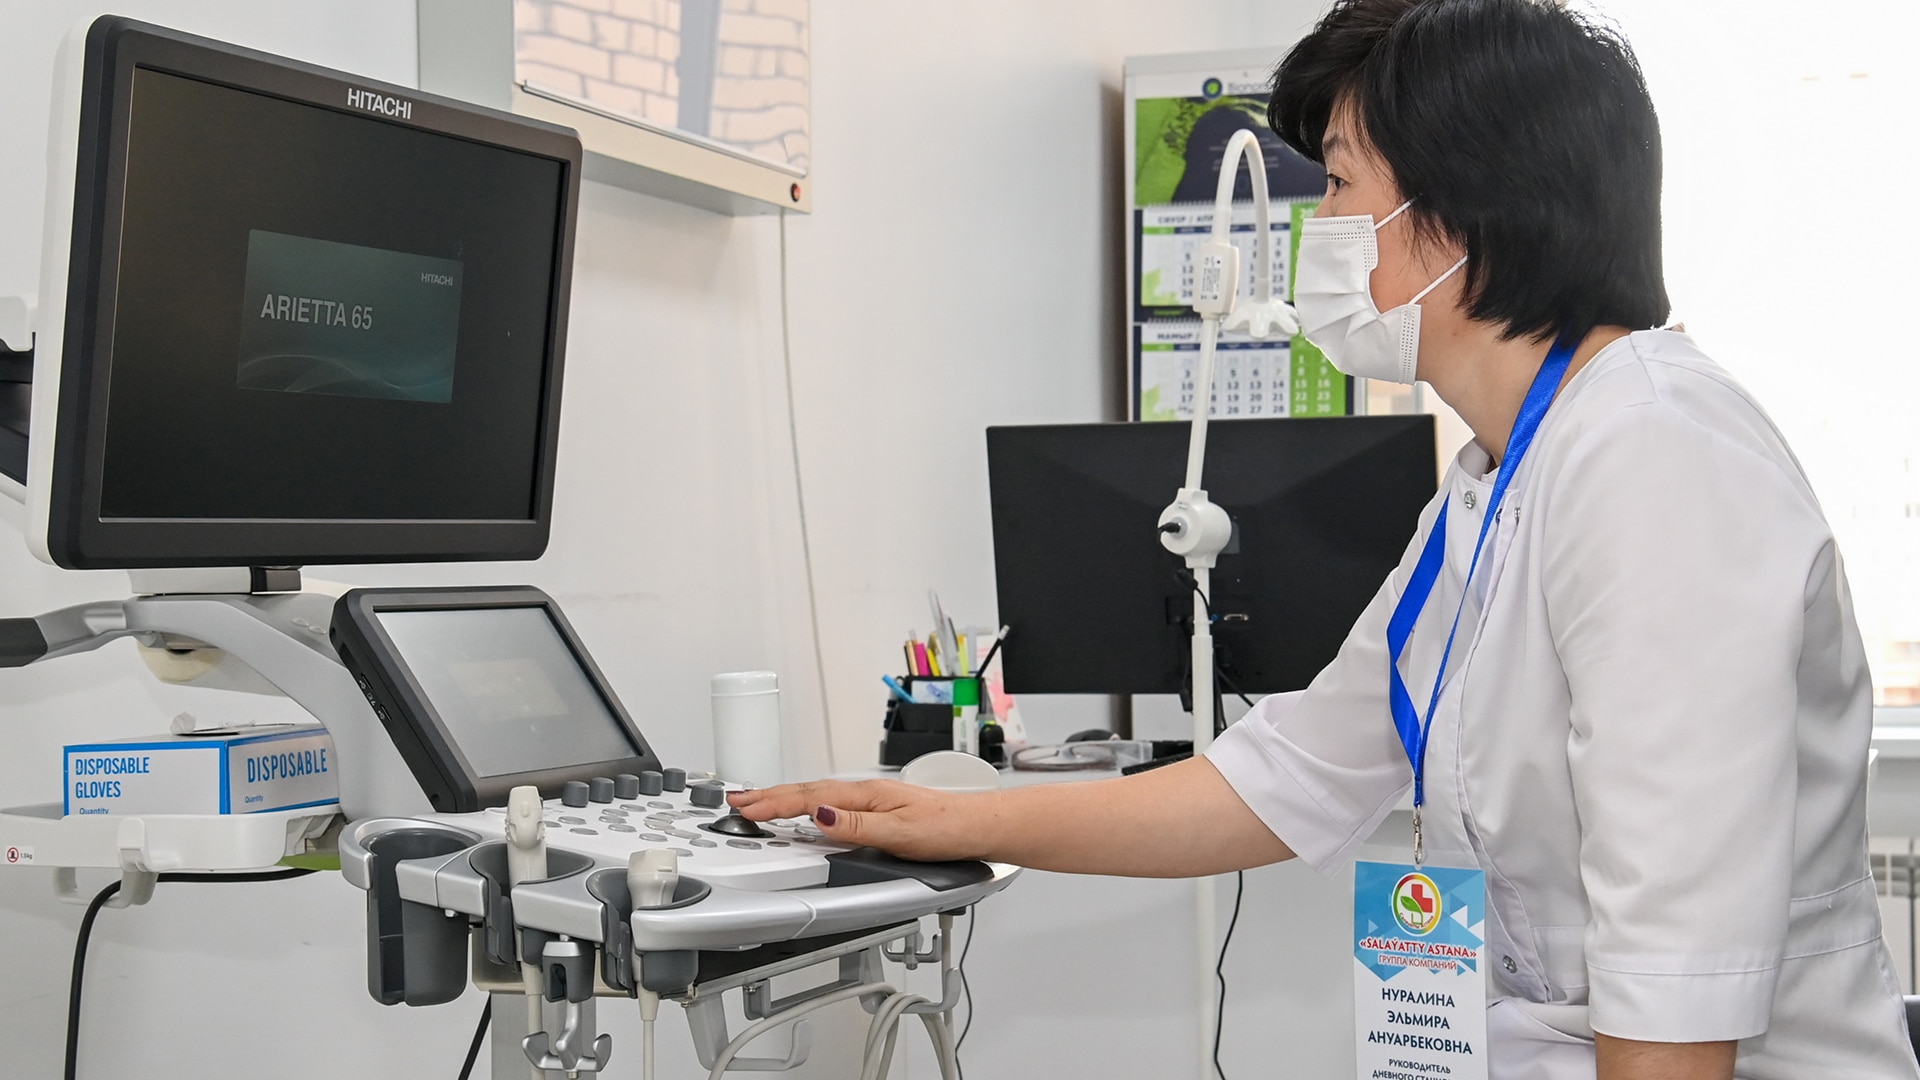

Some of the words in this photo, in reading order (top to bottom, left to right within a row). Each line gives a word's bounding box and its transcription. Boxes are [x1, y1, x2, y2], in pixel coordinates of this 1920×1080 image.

[347, 87, 412, 120] HITACHI
[1275, 238, 1282, 246] 2
[1182, 265, 1194, 274] 12
[1272, 262, 1284, 271] 16
[421, 272, 454, 287] HITACHI
[1182, 277, 1194, 286] 19
[1271, 274, 1284, 283] 23
[1271, 287, 1284, 296] 30
[260, 293, 347, 328] ARIETTA
[351, 305, 374, 330] 65
[1252, 368, 1259, 377] 6
[1182, 382, 1194, 391] 10
[1227, 381, 1239, 391] 12
[1250, 381, 1262, 390] 13
[1273, 380, 1284, 389] 14
[1182, 394, 1193, 403] 17
[1227, 394, 1239, 402] 19
[1249, 393, 1262, 402] 20
[1272, 392, 1284, 401] 21
[1227, 406, 1239, 415] 26
[1249, 405, 1262, 414] 27
[1272, 404, 1284, 414] 28
[75, 757, 150, 776] DISPOSABLE
[247, 748, 328, 783] DISPOSABLE
[75, 781, 121, 799] GLOVES
[245, 795, 264, 803] Quantity
[79, 807, 109, 815] Quantity
[1427, 944, 1478, 959] ASTANA»
[1378, 954, 1408, 966] ГРУППА
[1408, 958, 1458, 970] КОМПАНИЙ
[1381, 987, 1456, 1008] НУРАЛИНА
[1387, 1010, 1450, 1030] ЭЛЬМИРА
[1367, 1030, 1473, 1055] АНУАРБЕКОВНА
[1388, 1058, 1451, 1074] РУКОВОДИТЕЛЬ
[1372, 1069, 1414, 1080] ДНЕВНОГО
